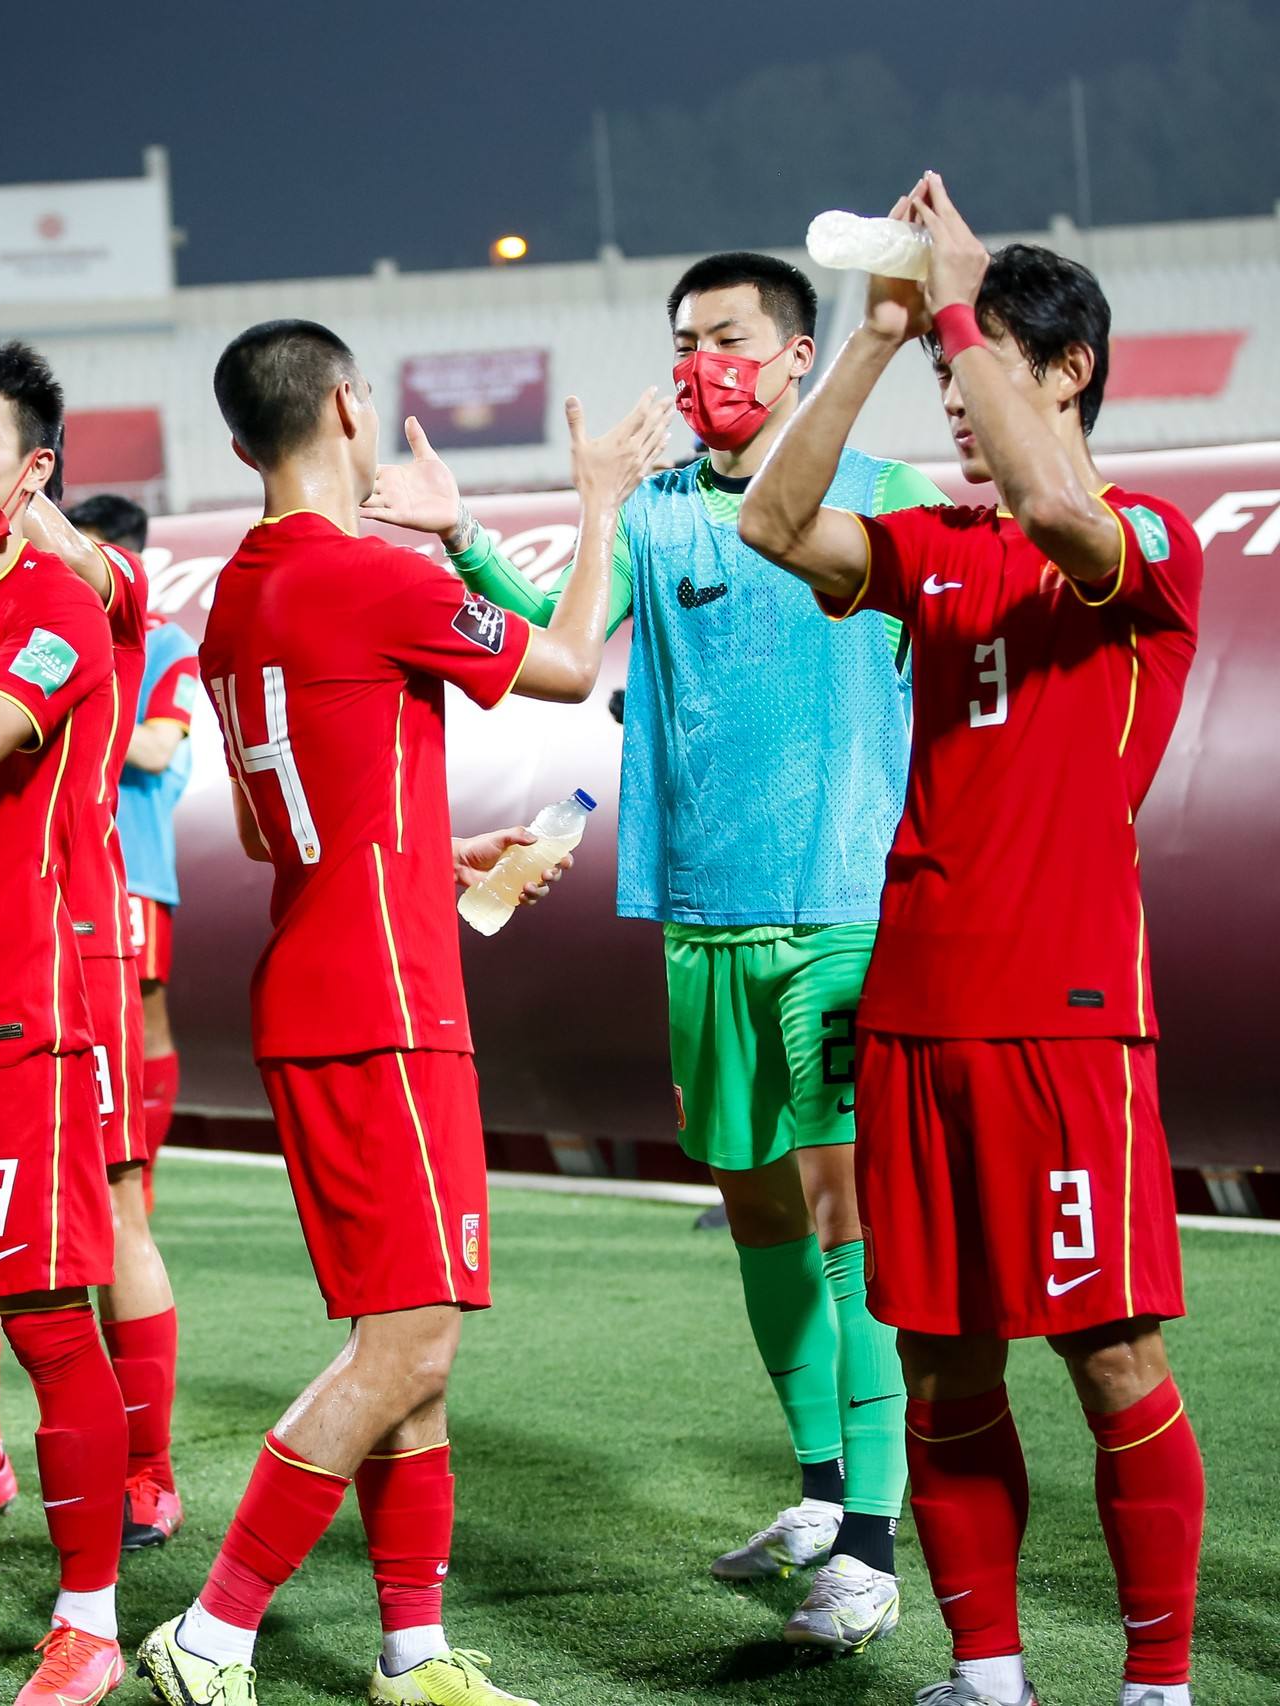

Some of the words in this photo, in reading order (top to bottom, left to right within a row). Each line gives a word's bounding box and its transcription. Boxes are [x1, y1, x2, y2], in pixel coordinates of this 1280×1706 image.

[969, 637, 1008, 729] 3
[210, 667, 321, 865] 14
[1050, 1169, 1096, 1260] 3
